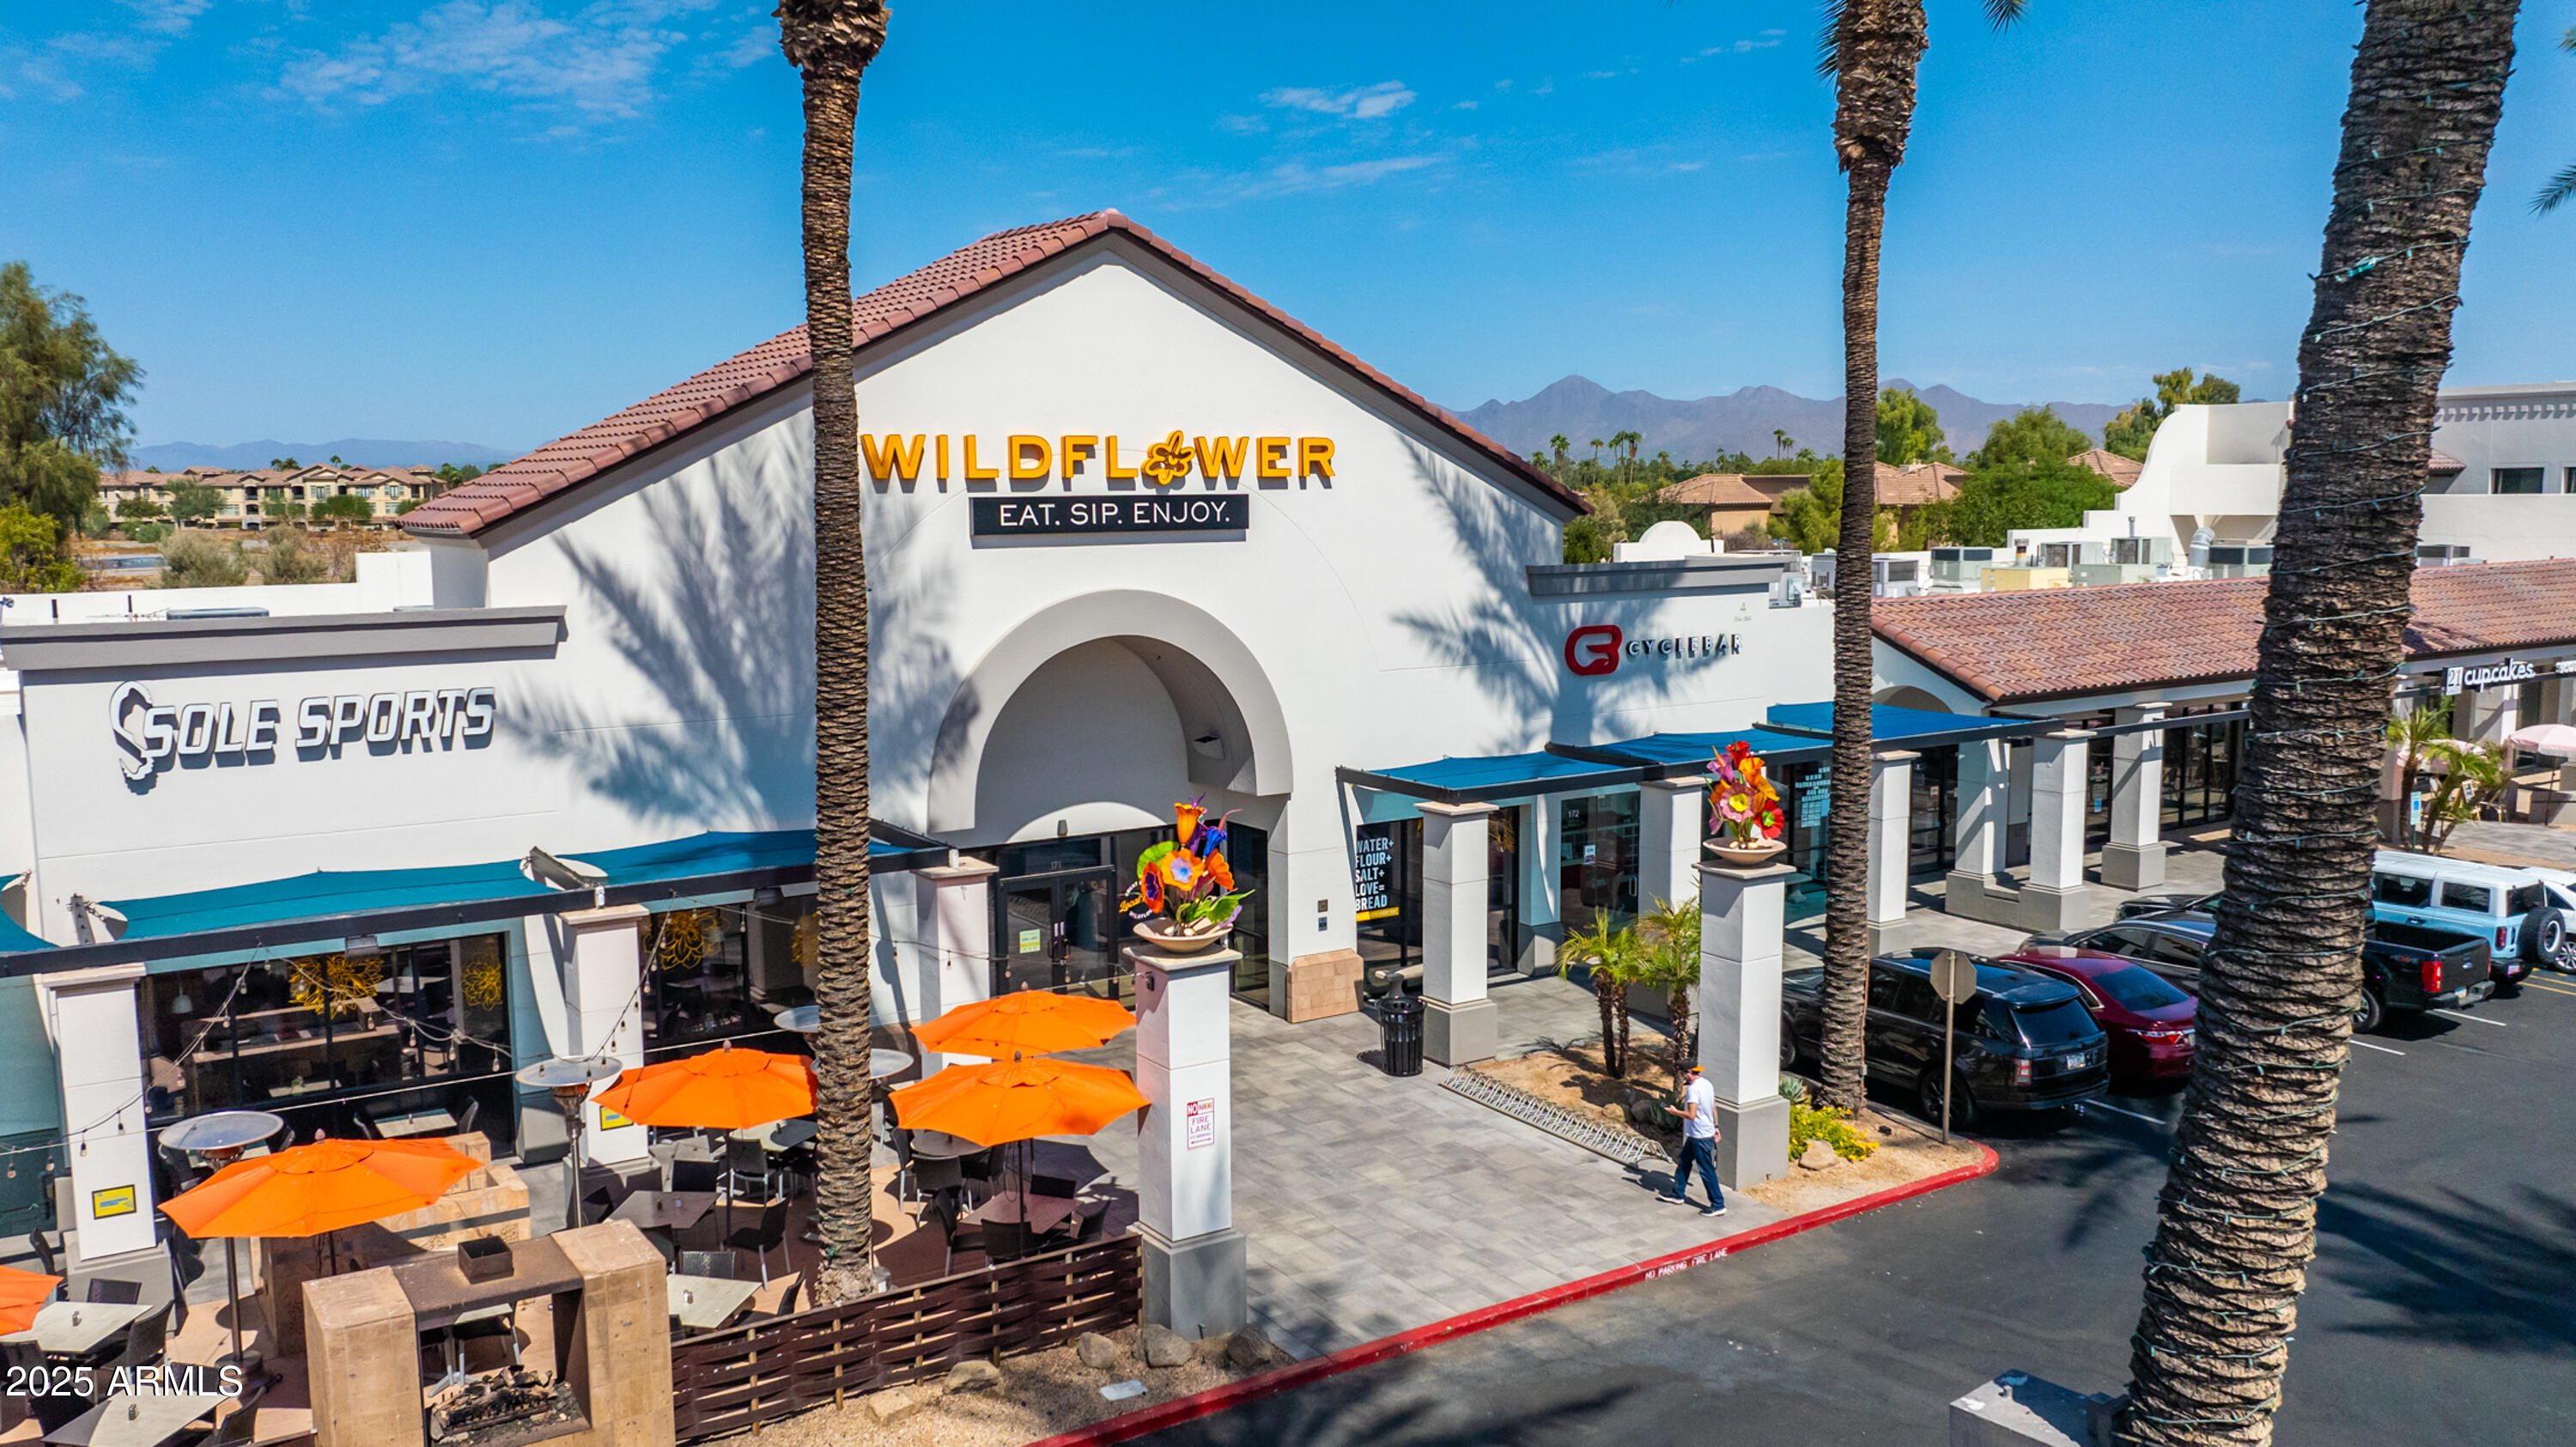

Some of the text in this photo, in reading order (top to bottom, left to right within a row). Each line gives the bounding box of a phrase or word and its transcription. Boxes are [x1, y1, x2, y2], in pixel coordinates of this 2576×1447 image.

[999, 501, 1230, 526] EAT. SIP. ENJOY.
[1627, 633, 1743, 657] CYCLEBAR
[2464, 658, 2536, 693] cupcakes
[143, 687, 496, 757] SOLE SPORTS
[1356, 894, 1388, 911] BREAD
[1188, 1103, 1198, 1116] NO
[1193, 1115, 1209, 1125] FIRE
[1190, 1123, 1211, 1134] LANE
[1645, 1270, 1656, 1280] NO
[1658, 1261, 1687, 1276] PARKING
[1710, 1247, 1728, 1261] LANE
